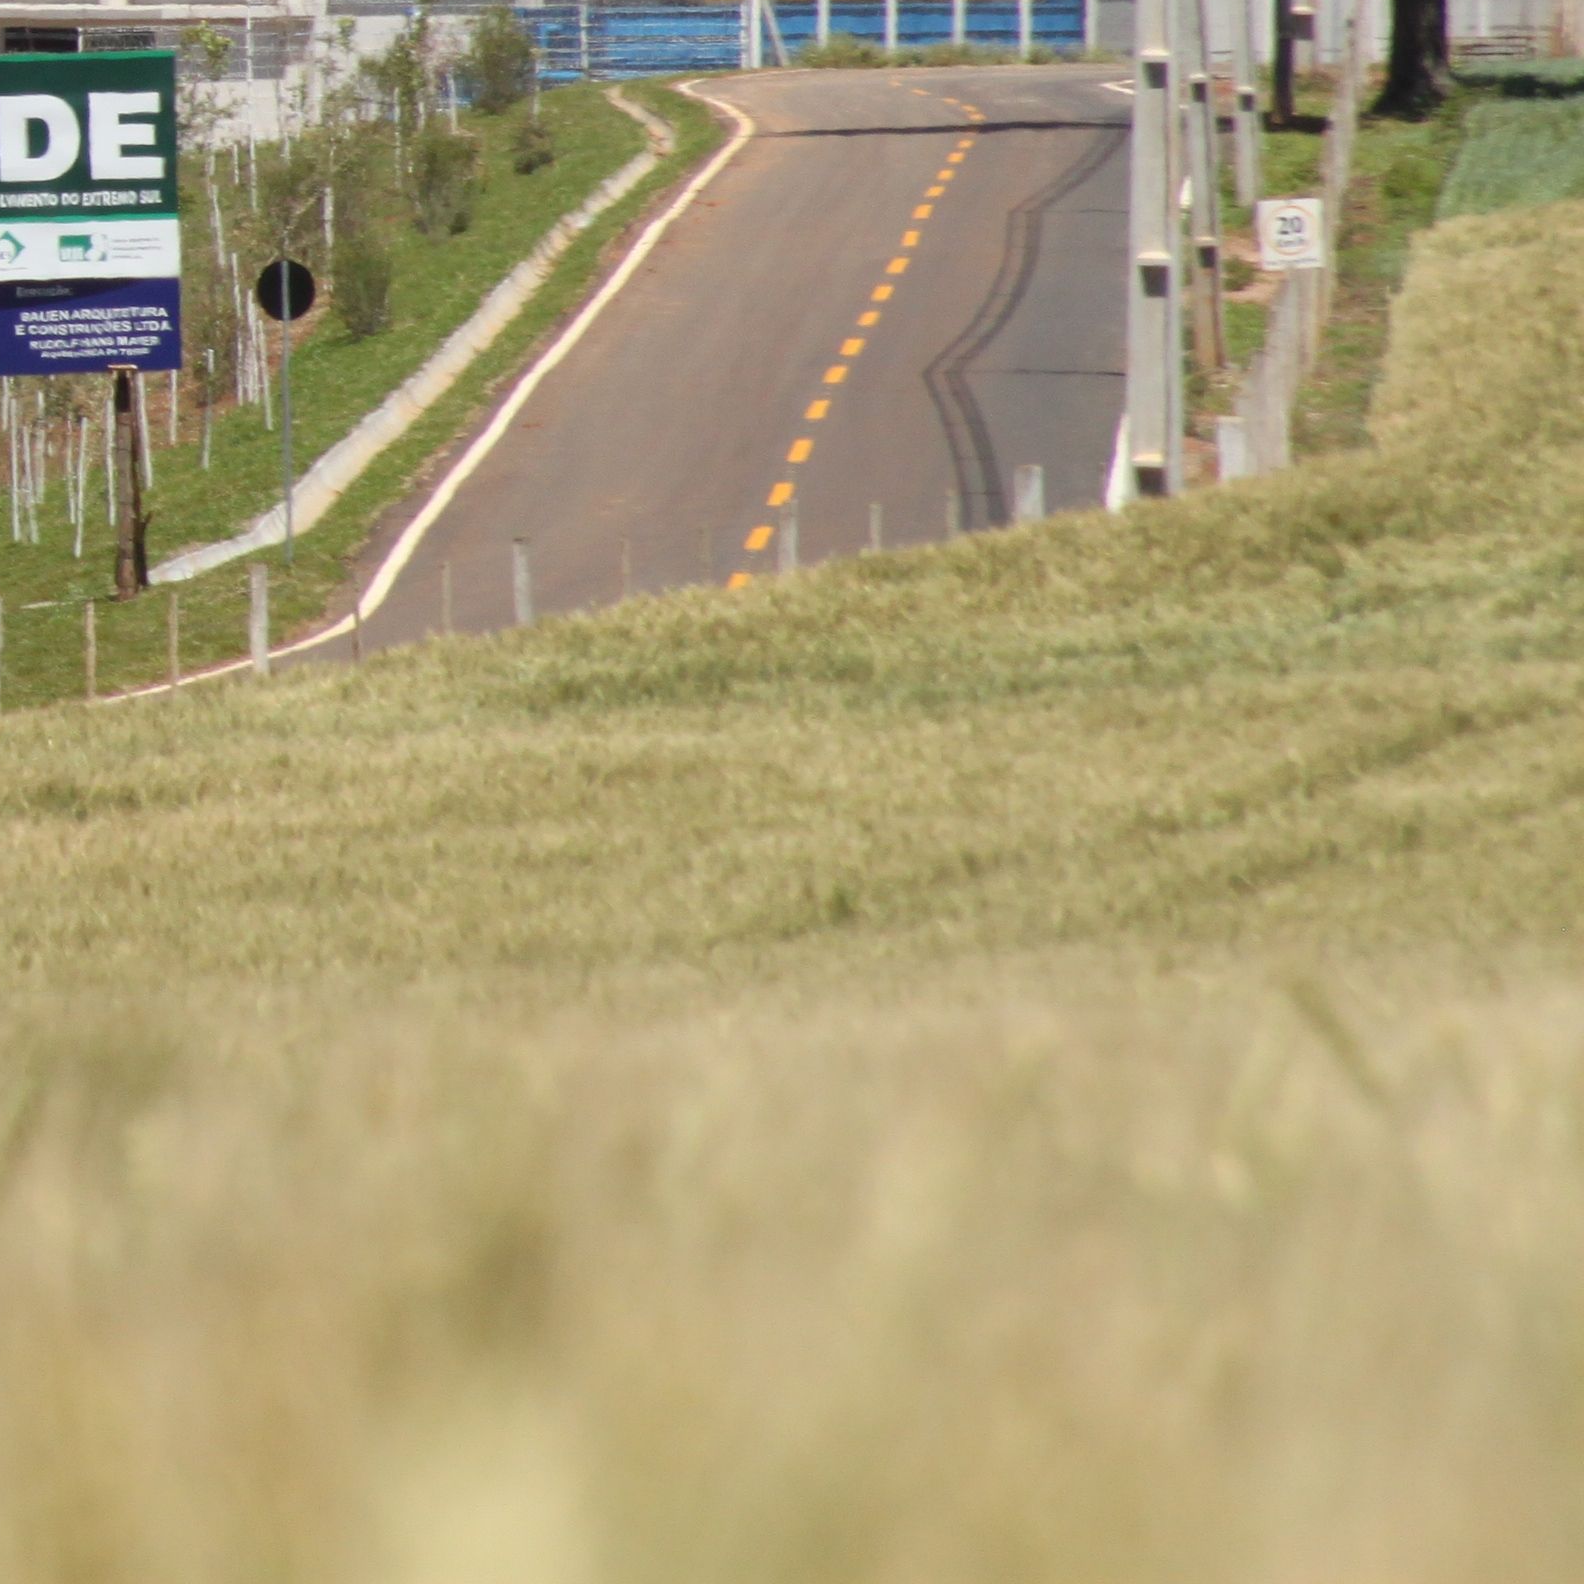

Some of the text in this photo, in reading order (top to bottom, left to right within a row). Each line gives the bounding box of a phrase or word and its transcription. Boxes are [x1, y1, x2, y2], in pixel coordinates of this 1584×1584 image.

[61, 193, 79, 206] DO
[82, 191, 137, 206] EXTREMO
[139, 190, 162, 204] SUL
[1275, 215, 1304, 235] 20
[70, 307, 168, 321] ARQUITETURA
[14, 325, 26, 336] E
[28, 321, 132, 336] CONSTRUÇÕES
